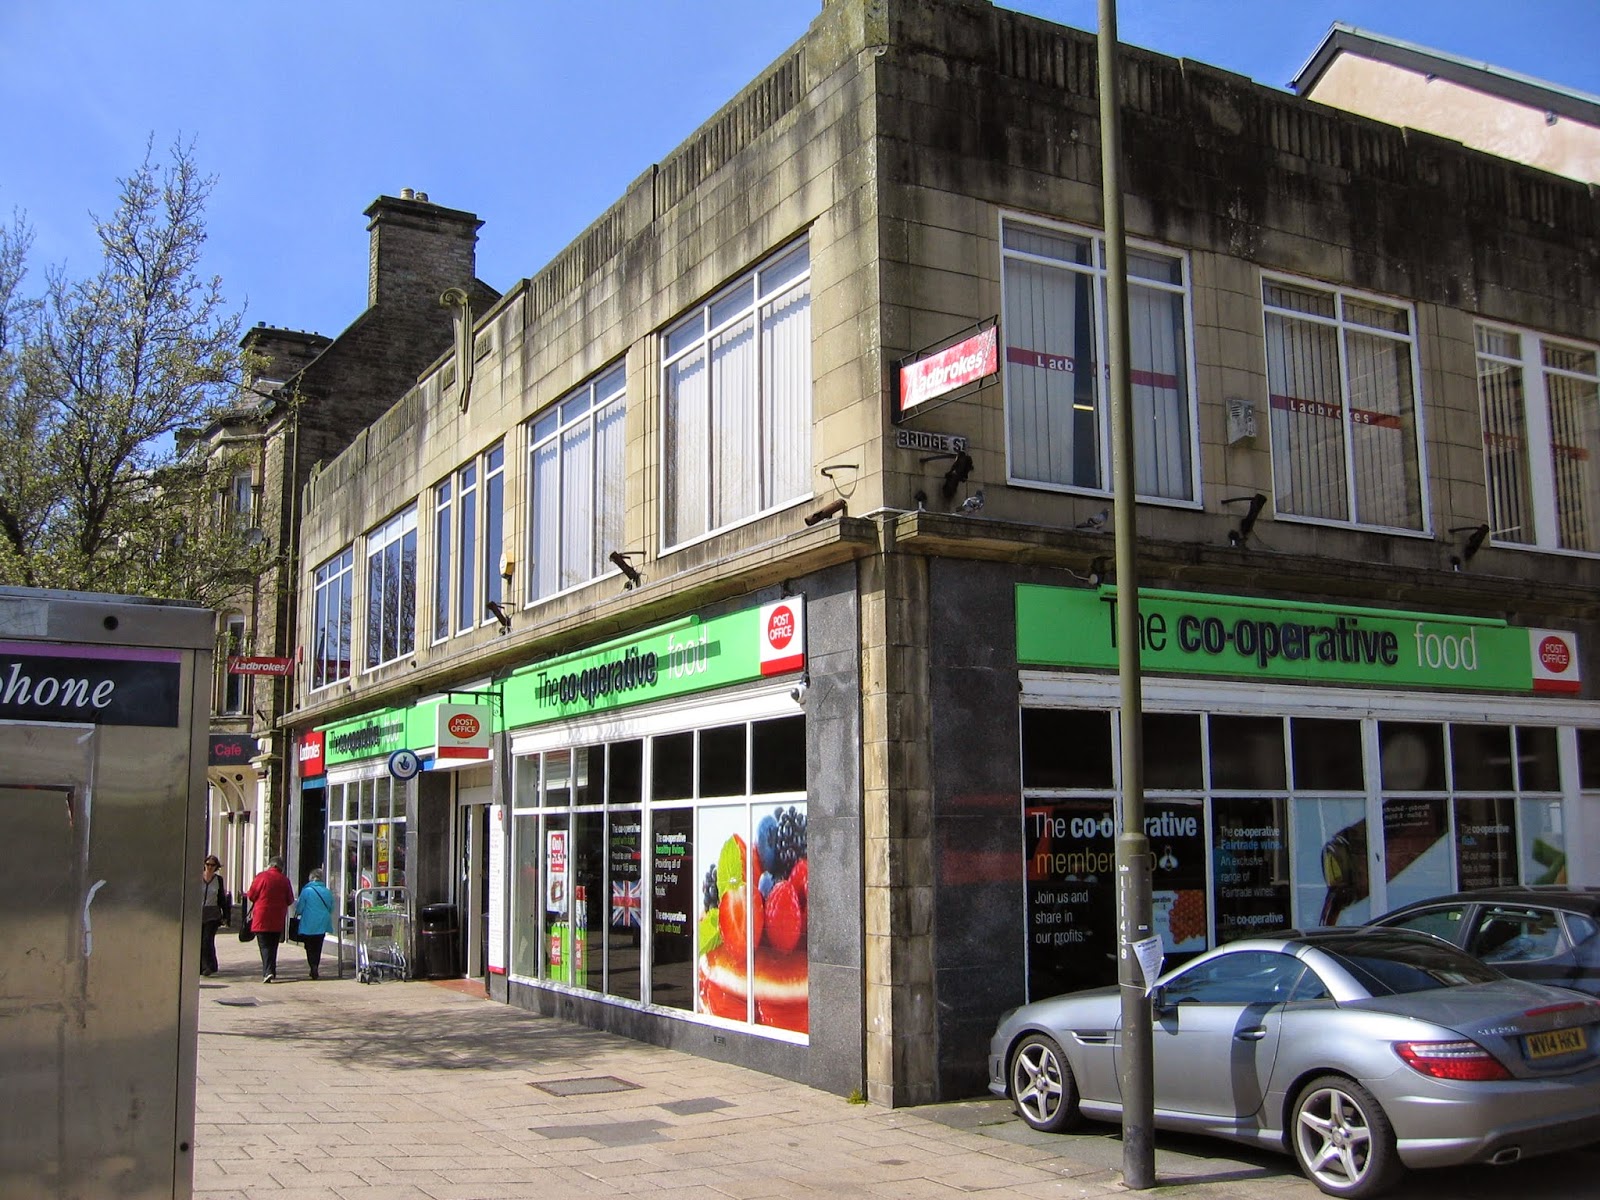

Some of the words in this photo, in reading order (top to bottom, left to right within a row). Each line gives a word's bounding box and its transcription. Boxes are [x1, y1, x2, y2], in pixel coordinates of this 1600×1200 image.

[911, 350, 984, 399] Ladbrokes
[898, 431, 949, 451] BRIDGE
[773, 613, 789, 628] POST
[769, 625, 792, 641] OFFICE
[1178, 614, 1399, 669] co-operative
[1413, 622, 1478, 671] food
[1545, 643, 1564, 653] POST
[1542, 653, 1568, 665] OFFICE
[236, 661, 286, 672] Ladbrokes
[537, 671, 559, 709] The
[558, 646, 658, 708] co-operative
[667, 625, 708, 680] food
[0, 663, 115, 708] hone
[455, 718, 473, 726] POST
[450, 725, 476, 733] OFFICE
[1031, 812, 1066, 838] The
[1070, 811, 1197, 839] co-orative
[1472, 824, 1510, 835] co-operative
[662, 832, 686, 844] co-operative
[1221, 826, 1233, 837] The
[1233, 826, 1280, 838] co-operative
[655, 845, 671, 856] healthy
[1221, 839, 1258, 850] Fairtrade
[1221, 856, 1230, 865] An
[1232, 856, 1263, 866] exclusive
[1221, 873, 1241, 883] range
[1243, 872, 1250, 881] of
[1035, 890, 1055, 904] Join
[1057, 893, 1069, 903] us
[1071, 890, 1088, 903] and
[1221, 886, 1253, 898] Fairtrade
[1035, 911, 1062, 924] share
[1064, 910, 1073, 922] in
[1223, 914, 1237, 925] The
[1236, 912, 1284, 926] co-operative
[1035, 933, 1052, 944] our
